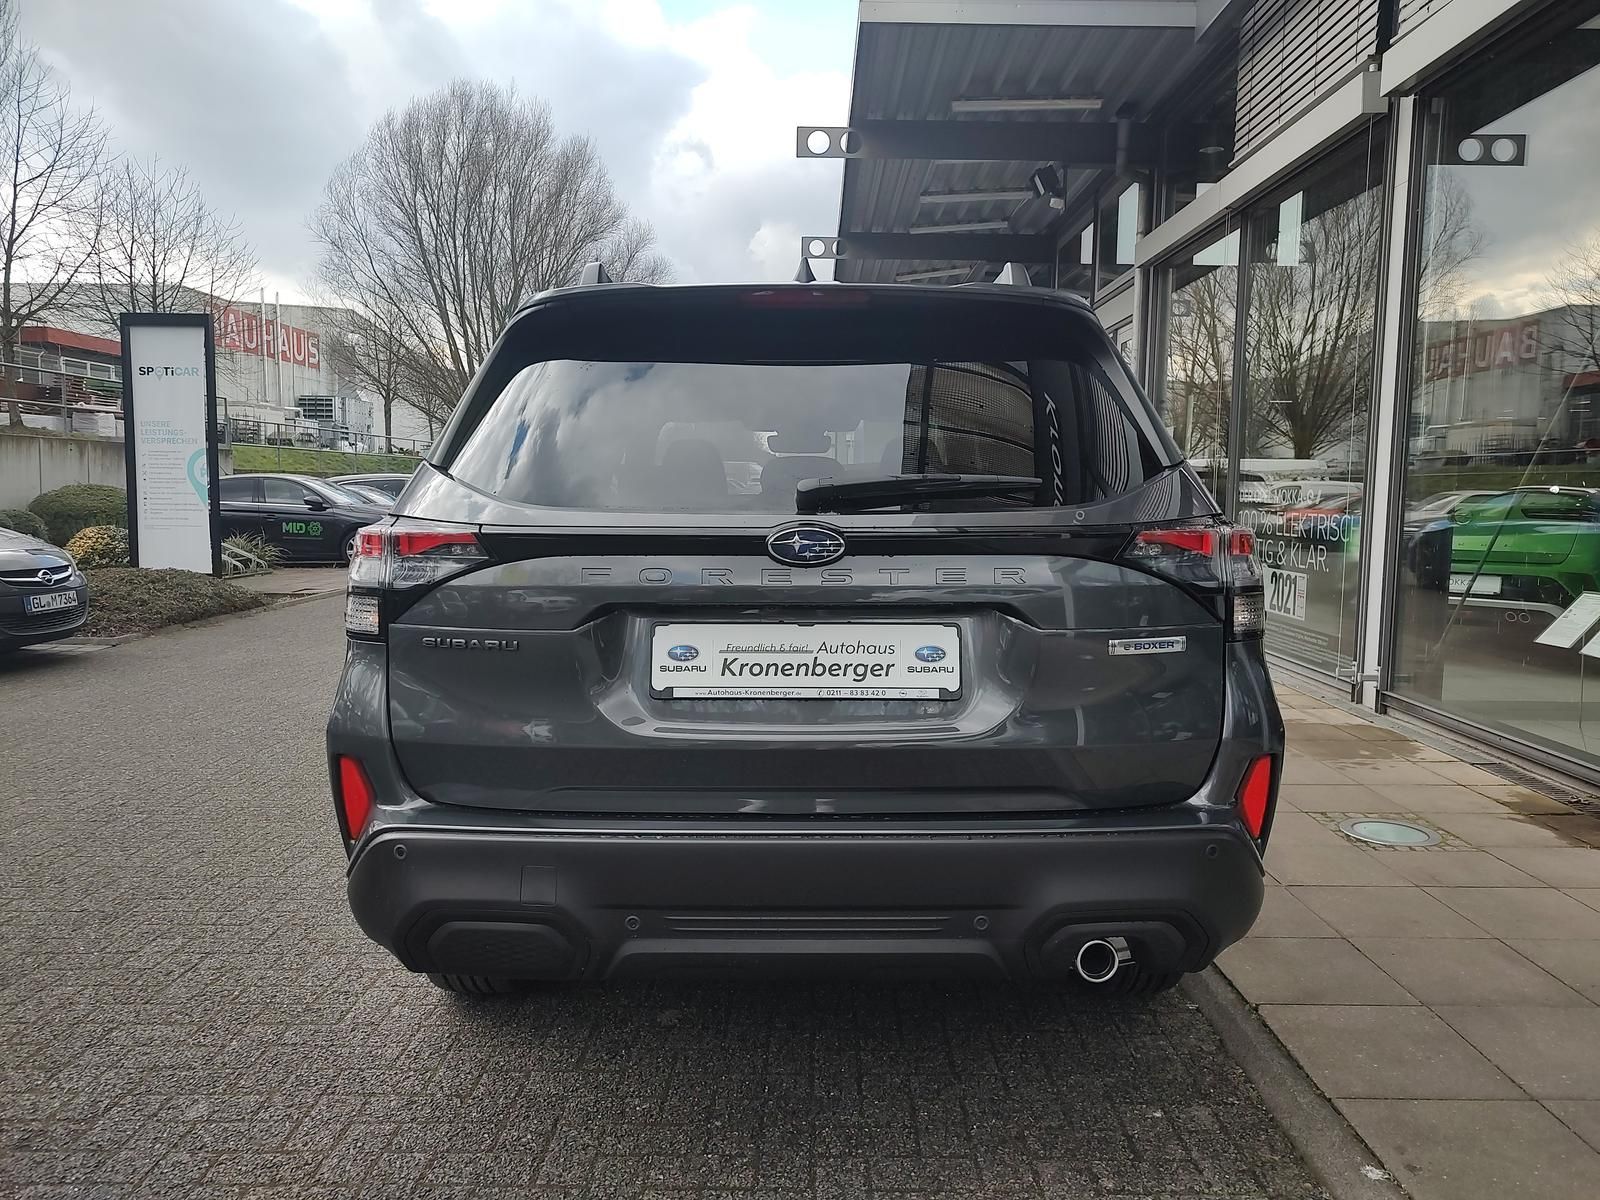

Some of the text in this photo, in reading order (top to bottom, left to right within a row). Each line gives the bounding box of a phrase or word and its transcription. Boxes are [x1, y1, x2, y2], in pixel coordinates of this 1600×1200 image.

[1276, 540, 1288, 566] &
[1289, 542, 1330, 574] KLAR.
[580, 566, 1028, 586] FORESTER
[1269, 570, 1298, 616] 2021
[31, 597, 46, 609] GL
[422, 637, 519, 651] SUBARU
[726, 639, 896, 655] Freundlich & fair! Autohaus
[659, 665, 707, 673] SUBARU
[720, 656, 896, 683] Kronenberger
[906, 666, 955, 674] SUBARU
[826, 689, 842, 697] 0211
[850, 689, 859, 697] 83
[860, 689, 869, 697] 83
[870, 689, 880, 697] 42
